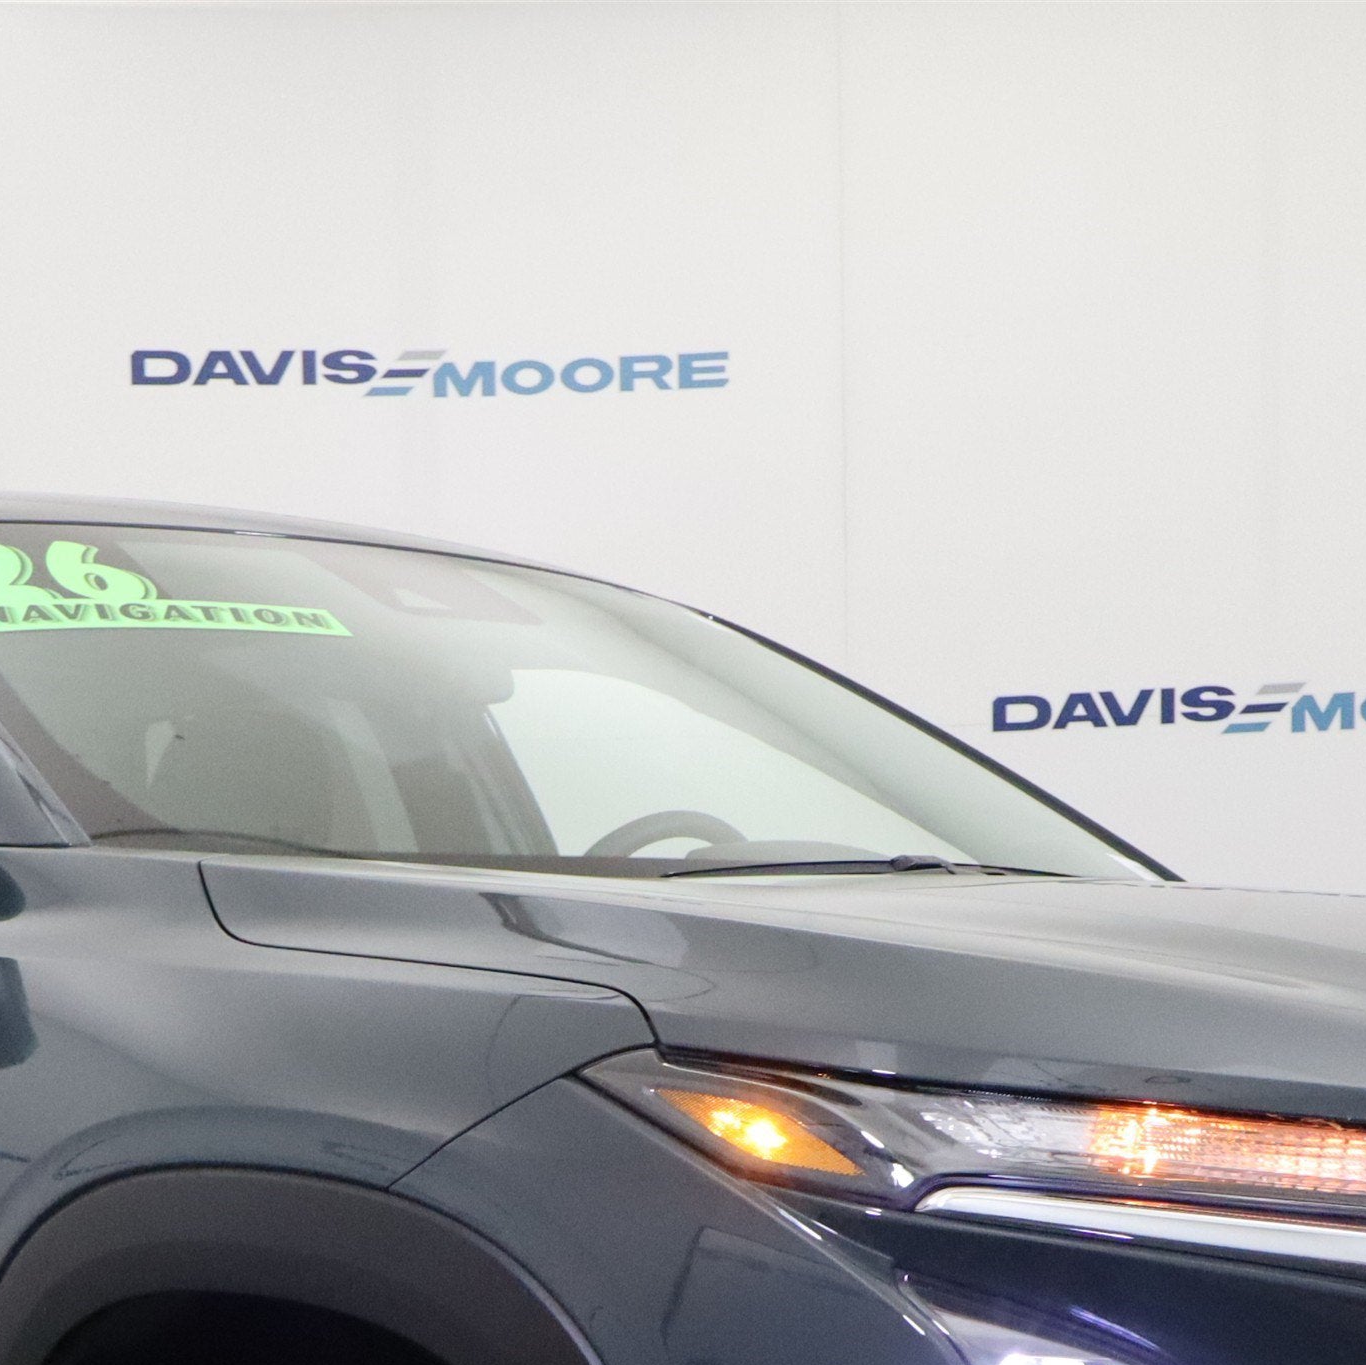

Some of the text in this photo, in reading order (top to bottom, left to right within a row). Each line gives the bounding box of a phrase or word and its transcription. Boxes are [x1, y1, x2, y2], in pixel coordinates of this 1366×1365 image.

[131, 349, 730, 398] DAVIS MOORE
[991, 685, 1237, 733] DAVIS
